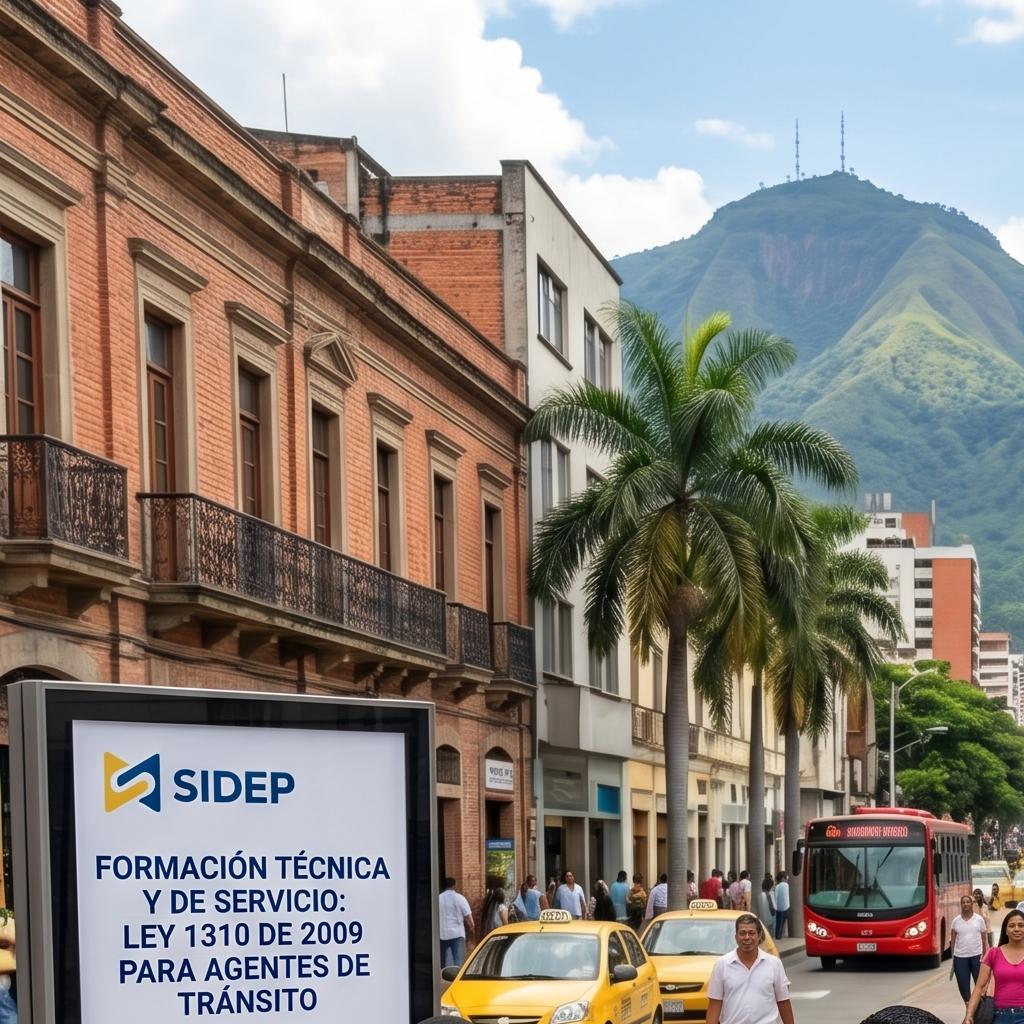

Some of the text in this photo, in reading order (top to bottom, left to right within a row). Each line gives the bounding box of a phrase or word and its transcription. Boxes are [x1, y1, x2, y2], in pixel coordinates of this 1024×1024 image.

[174, 769, 295, 803] SIDEP
[96, 850, 390, 879] FORMACIÓN TÉCNICA
[143, 889, 345, 914] Y DE SERVICIO:
[124, 921, 362, 949] LEY 1310 DE 2009
[120, 954, 370, 983] PARA AGENTES DE
[178, 985, 317, 1015] TRÁNSITO
